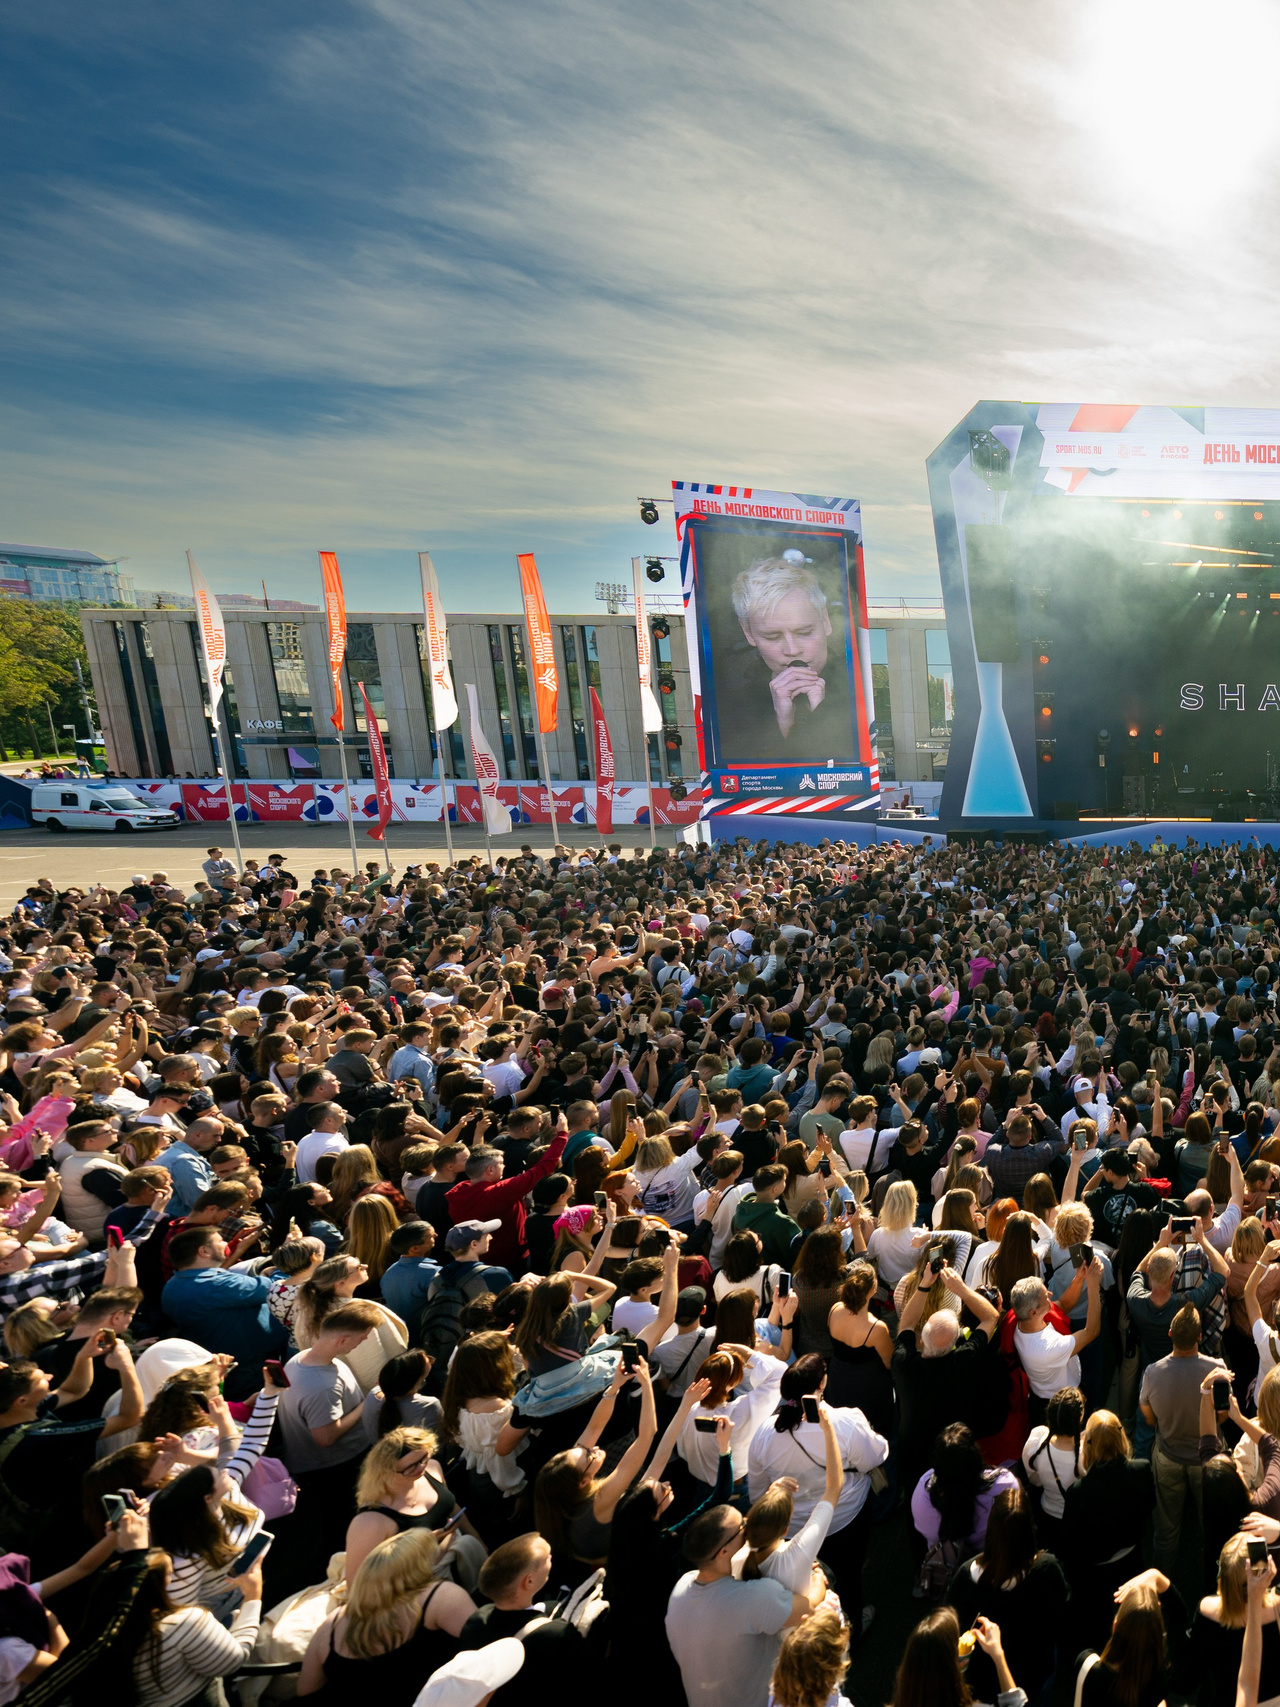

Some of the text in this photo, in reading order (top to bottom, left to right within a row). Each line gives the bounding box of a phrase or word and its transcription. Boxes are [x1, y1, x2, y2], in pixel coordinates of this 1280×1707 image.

[1055, 444, 1102, 455] SPORT.MOS.RU
[1161, 445, 1189, 454] ЛЕТО
[1203, 443, 1240, 464] ДЕНЬ
[692, 499, 845, 525] ДЕНЬ МОСКОВСКОГО СПОРТА
[198, 590, 215, 660] МОСКОВСКИЙ
[526, 594, 545, 664] МОСКОВСКИЙ
[246, 720, 283, 730] КАФЕ
[596, 720, 609, 777] МОСКОВСКИЙ
[478, 752, 498, 778] СПОРТ
[817, 771, 863, 782] МОСКОВСКИЙ
[817, 781, 840, 790] СПОРТ
